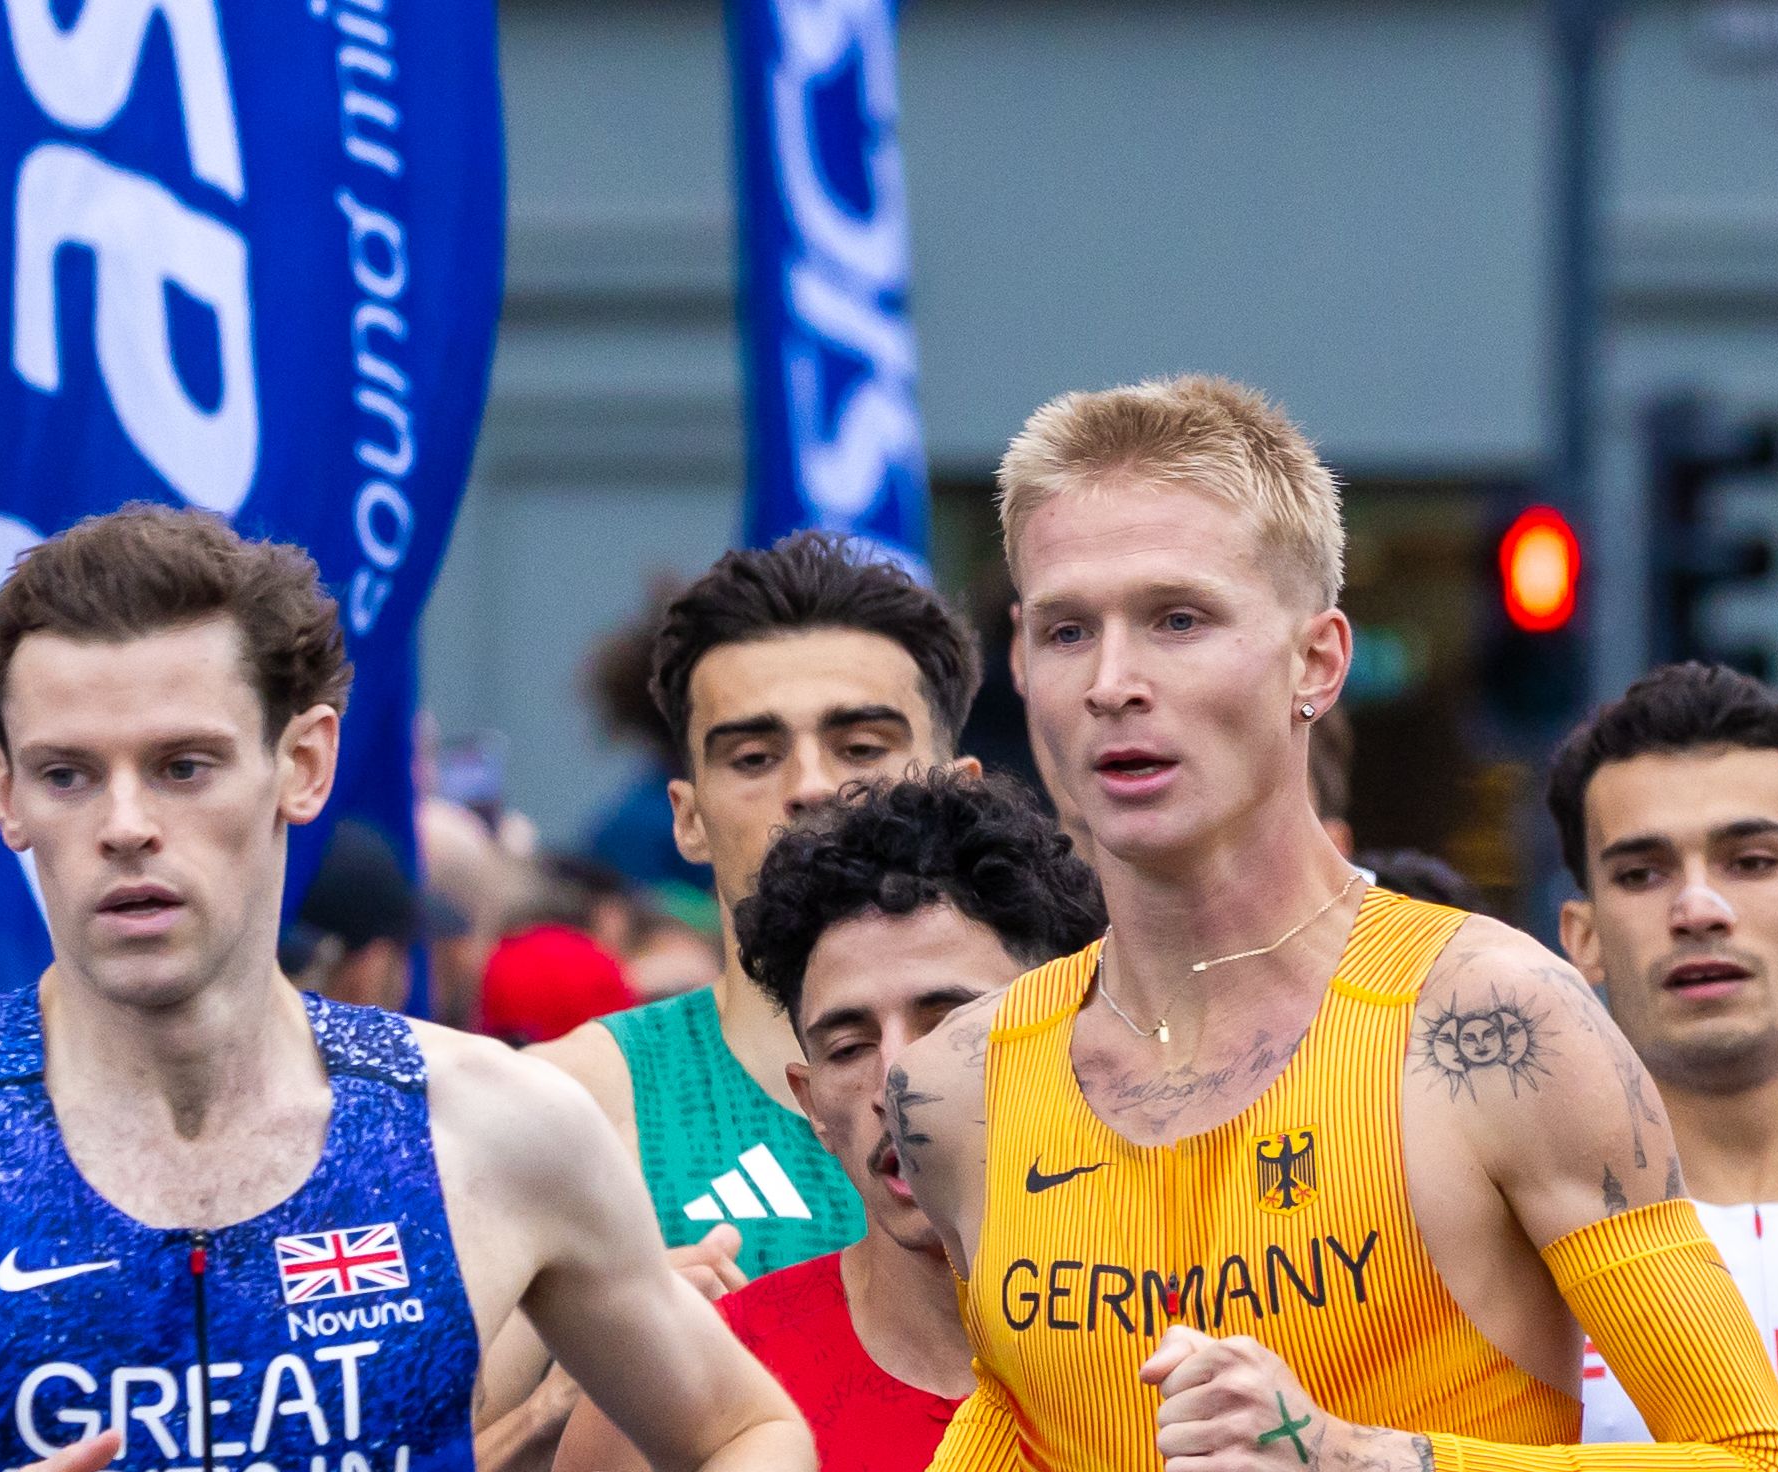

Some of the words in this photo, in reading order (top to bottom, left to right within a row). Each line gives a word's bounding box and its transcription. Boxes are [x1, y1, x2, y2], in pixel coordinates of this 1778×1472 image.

[333, 186, 415, 638] sound
[288, 1298, 425, 1342] Novuna
[1002, 1230, 1378, 1337] GERMANY
[15, 1341, 381, 1461] GREAT
